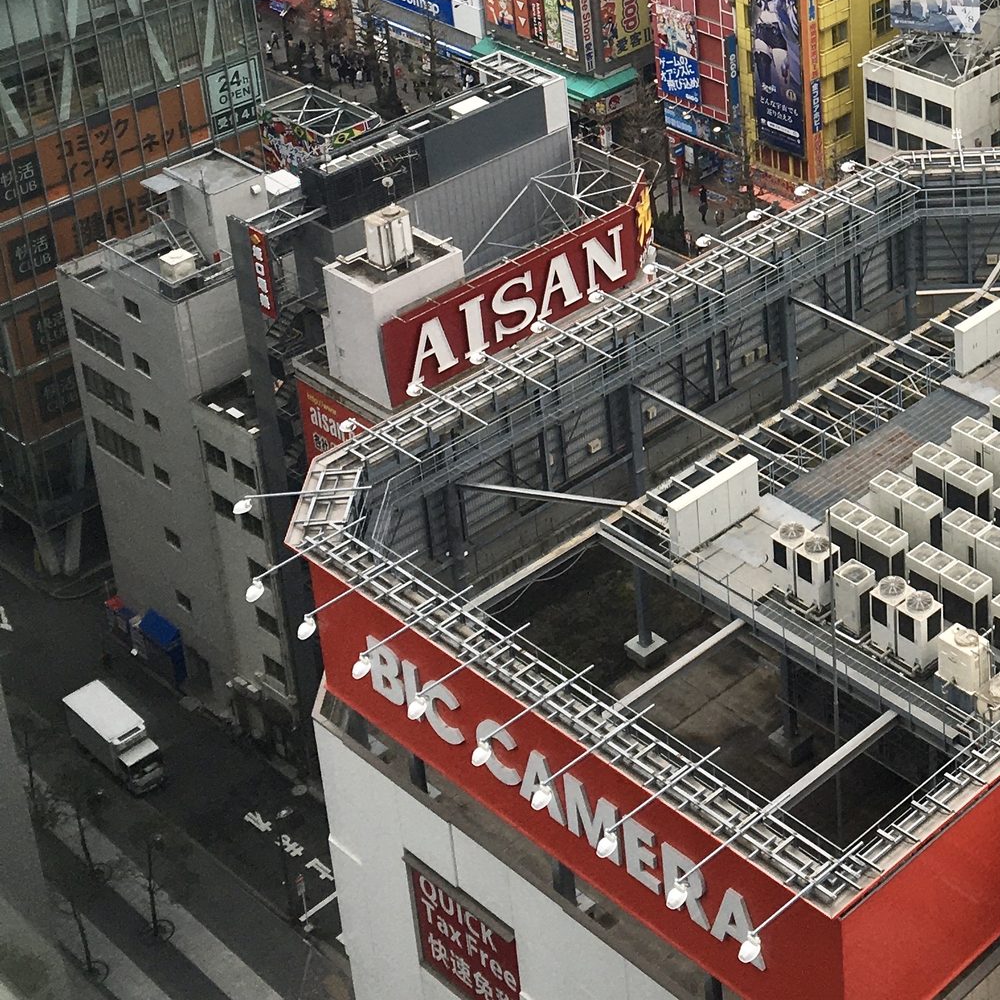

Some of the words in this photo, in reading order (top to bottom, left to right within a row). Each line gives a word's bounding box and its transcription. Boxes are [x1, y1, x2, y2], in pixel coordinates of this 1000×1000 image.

[581, 7, 592, 42] Shop
[658, 55, 688, 70] ゲームの
[660, 65, 695, 82] オアシスに
[219, 84, 251, 105] OPEN
[759, 95, 799, 119] どんな宇宙でも
[55, 117, 129, 161] コミック
[69, 120, 193, 179] インターネット
[0, 160, 35, 187] 快活
[15, 234, 49, 262] 快活
[408, 222, 628, 386] AISAN
[366, 634, 466, 746] BIC
[472, 718, 768, 972] CAMERA
[419, 875, 498, 953] QUICK
[421, 897, 463, 949] Tax
[465, 932, 517, 992] Free
